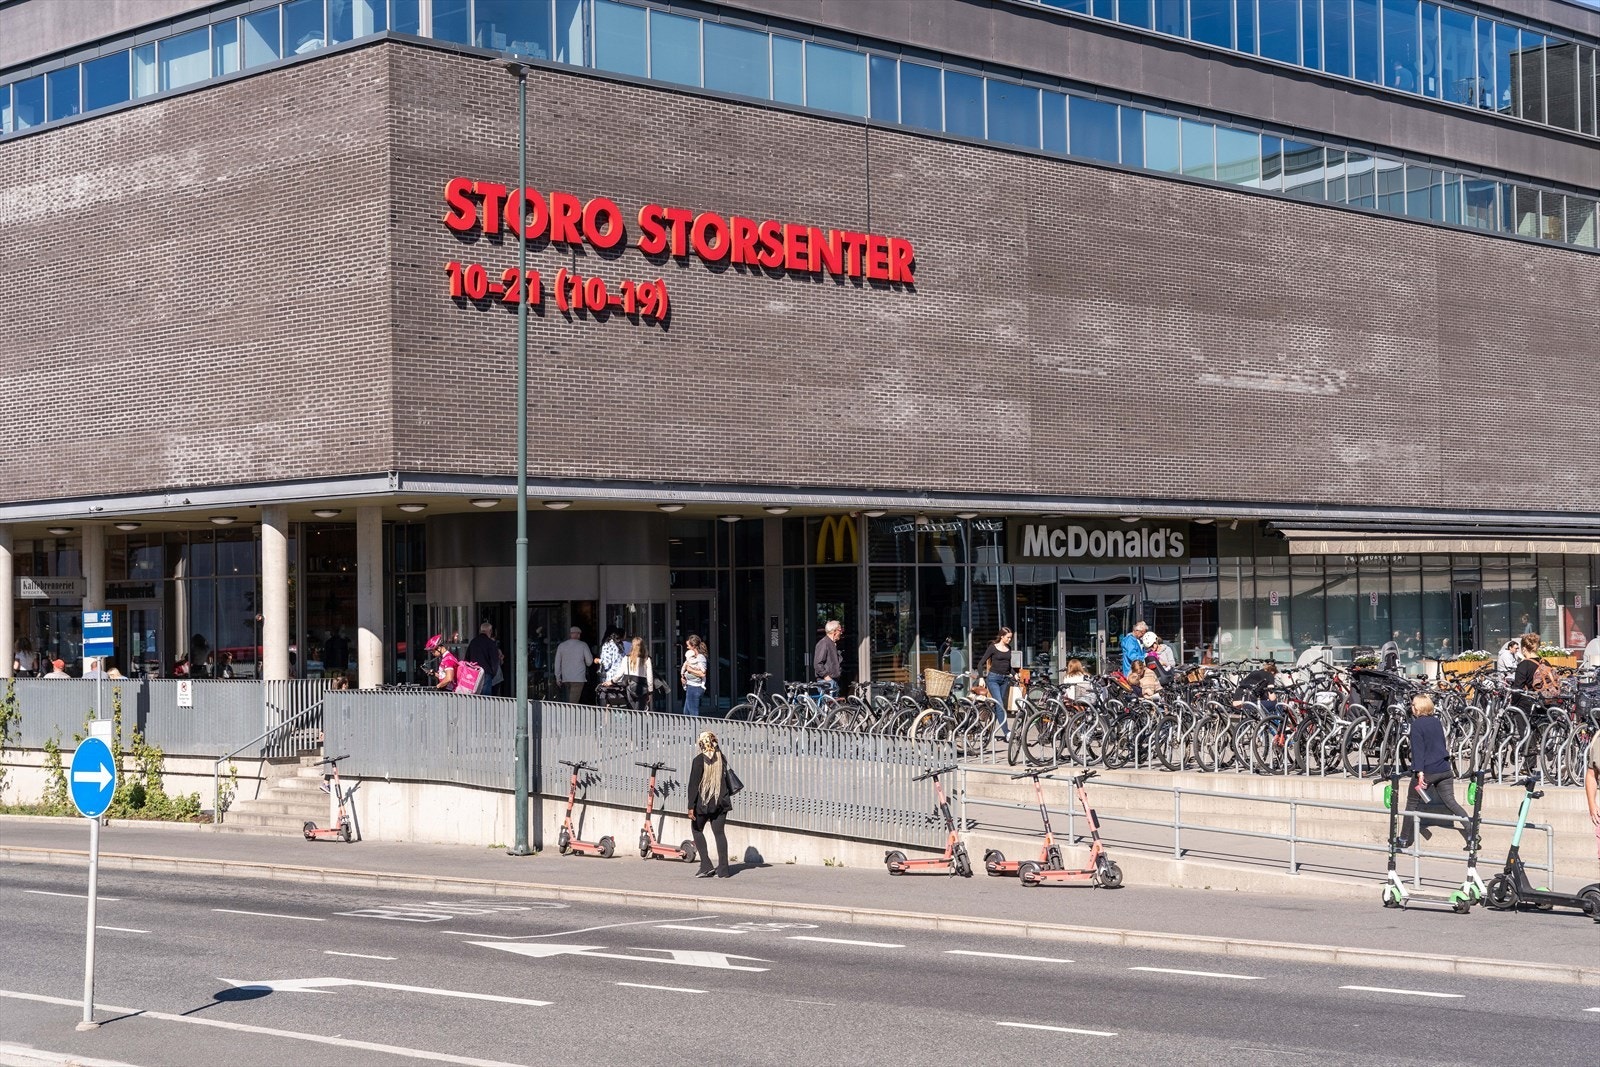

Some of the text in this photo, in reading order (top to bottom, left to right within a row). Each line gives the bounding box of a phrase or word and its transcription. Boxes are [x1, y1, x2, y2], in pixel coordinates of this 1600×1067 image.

[444, 177, 915, 283] STORO STORSENTER
[554, 267, 668, 321] (10-19)
[1023, 525, 1185, 558] McDonald's
[332, 899, 571, 923] BUSS
